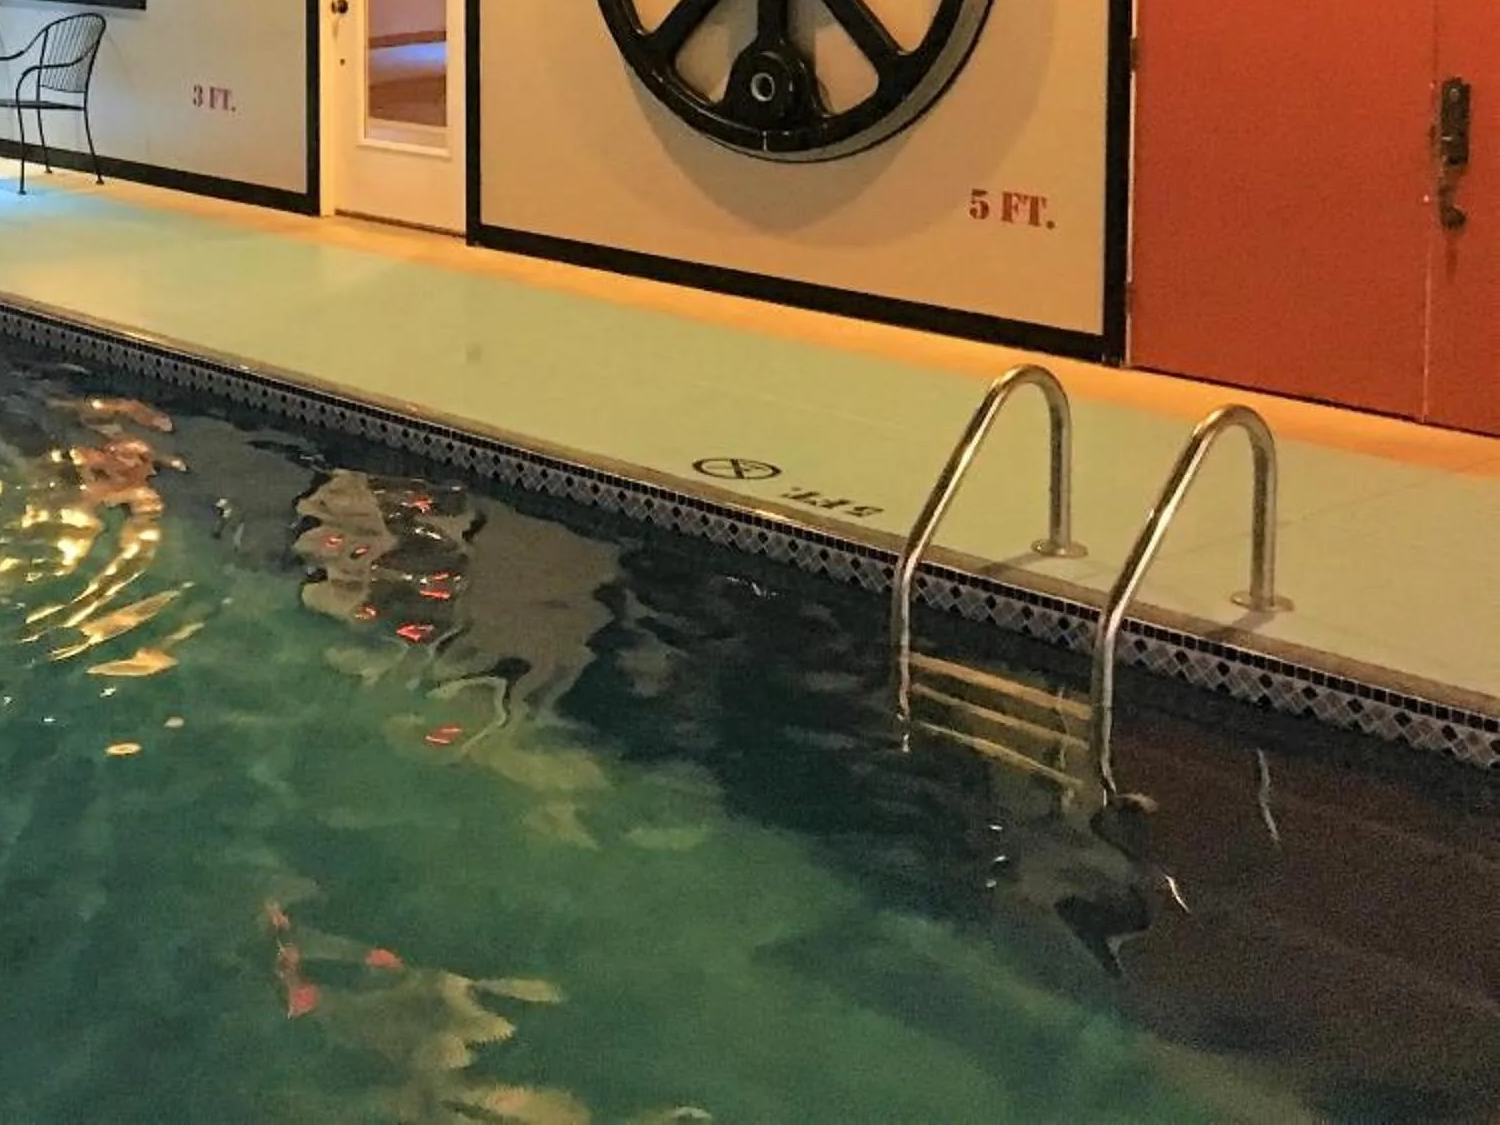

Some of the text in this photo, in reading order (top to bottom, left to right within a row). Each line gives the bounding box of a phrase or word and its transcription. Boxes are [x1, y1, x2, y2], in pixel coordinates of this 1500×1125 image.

[192, 84, 237, 113] 3 FT.
[969, 188, 1056, 230] 5 FT.
